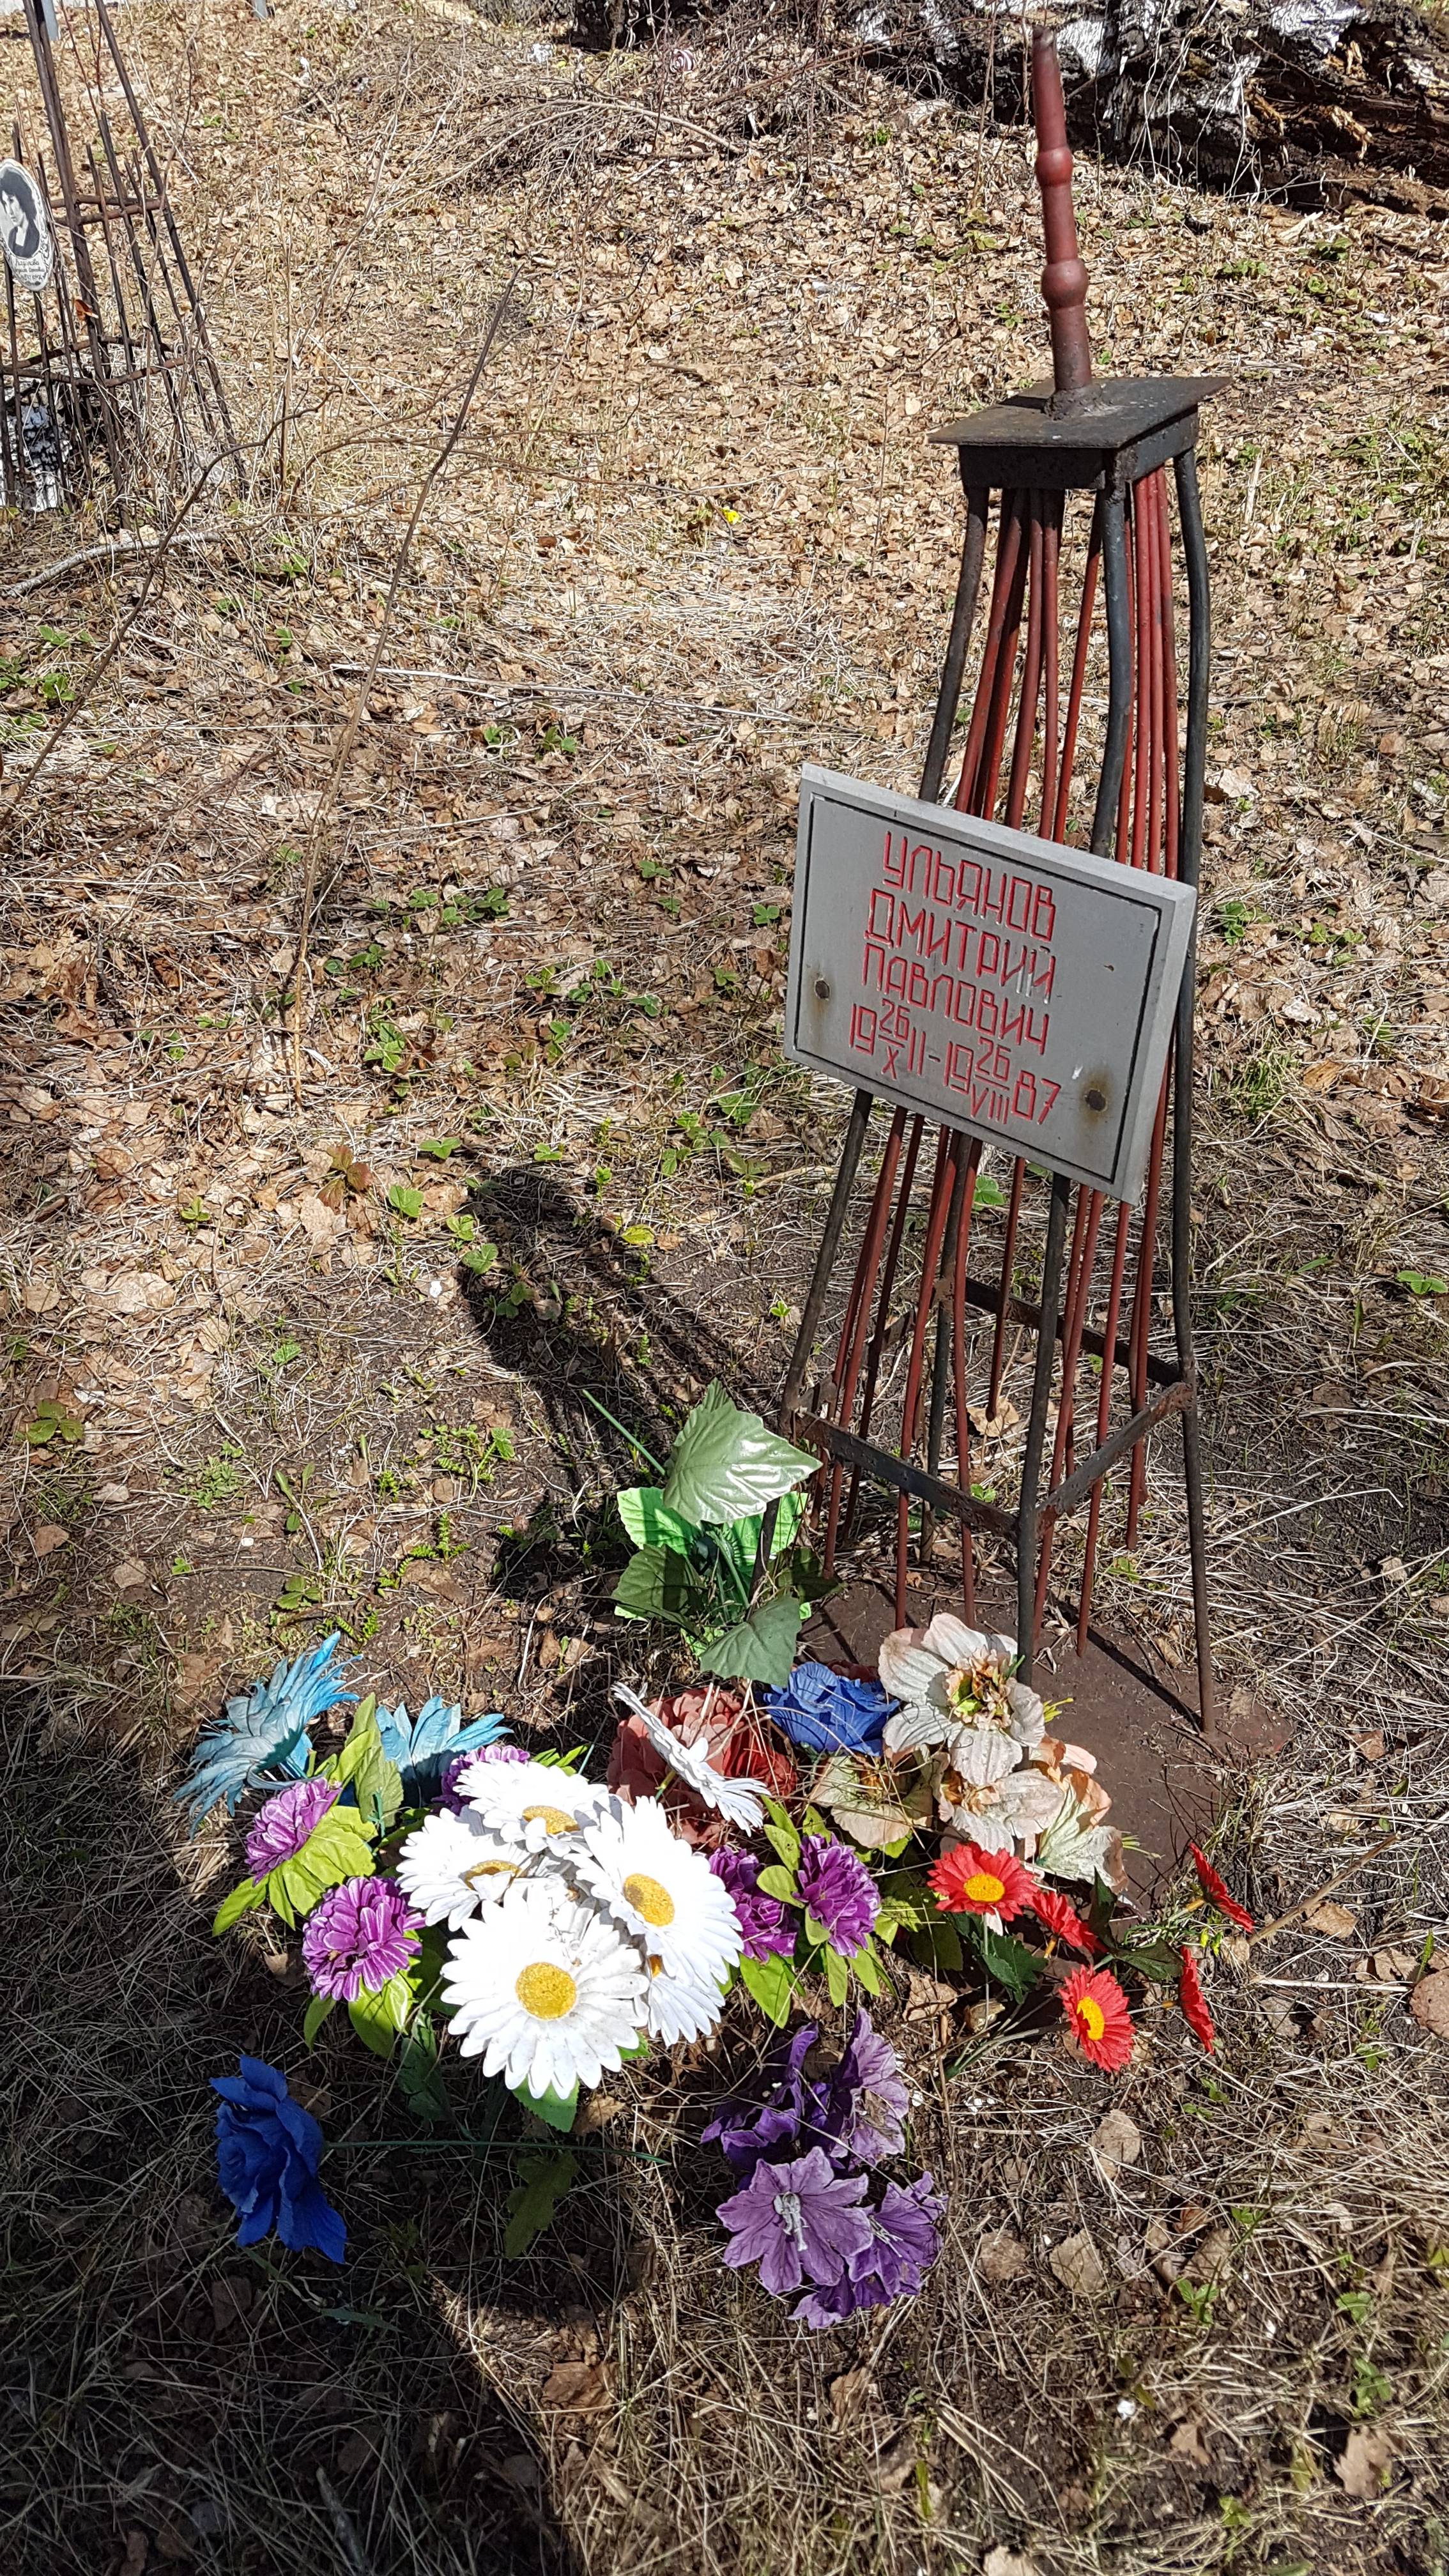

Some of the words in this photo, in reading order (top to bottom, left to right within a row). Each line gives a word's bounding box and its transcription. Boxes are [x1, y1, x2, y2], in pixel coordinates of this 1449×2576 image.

[883, 831, 1056, 942] УЛЬЯНОВ
[861, 943, 1049, 1055] ПАВЛОВИЧ
[864, 888, 1056, 1004] ДМИТРИЙ
